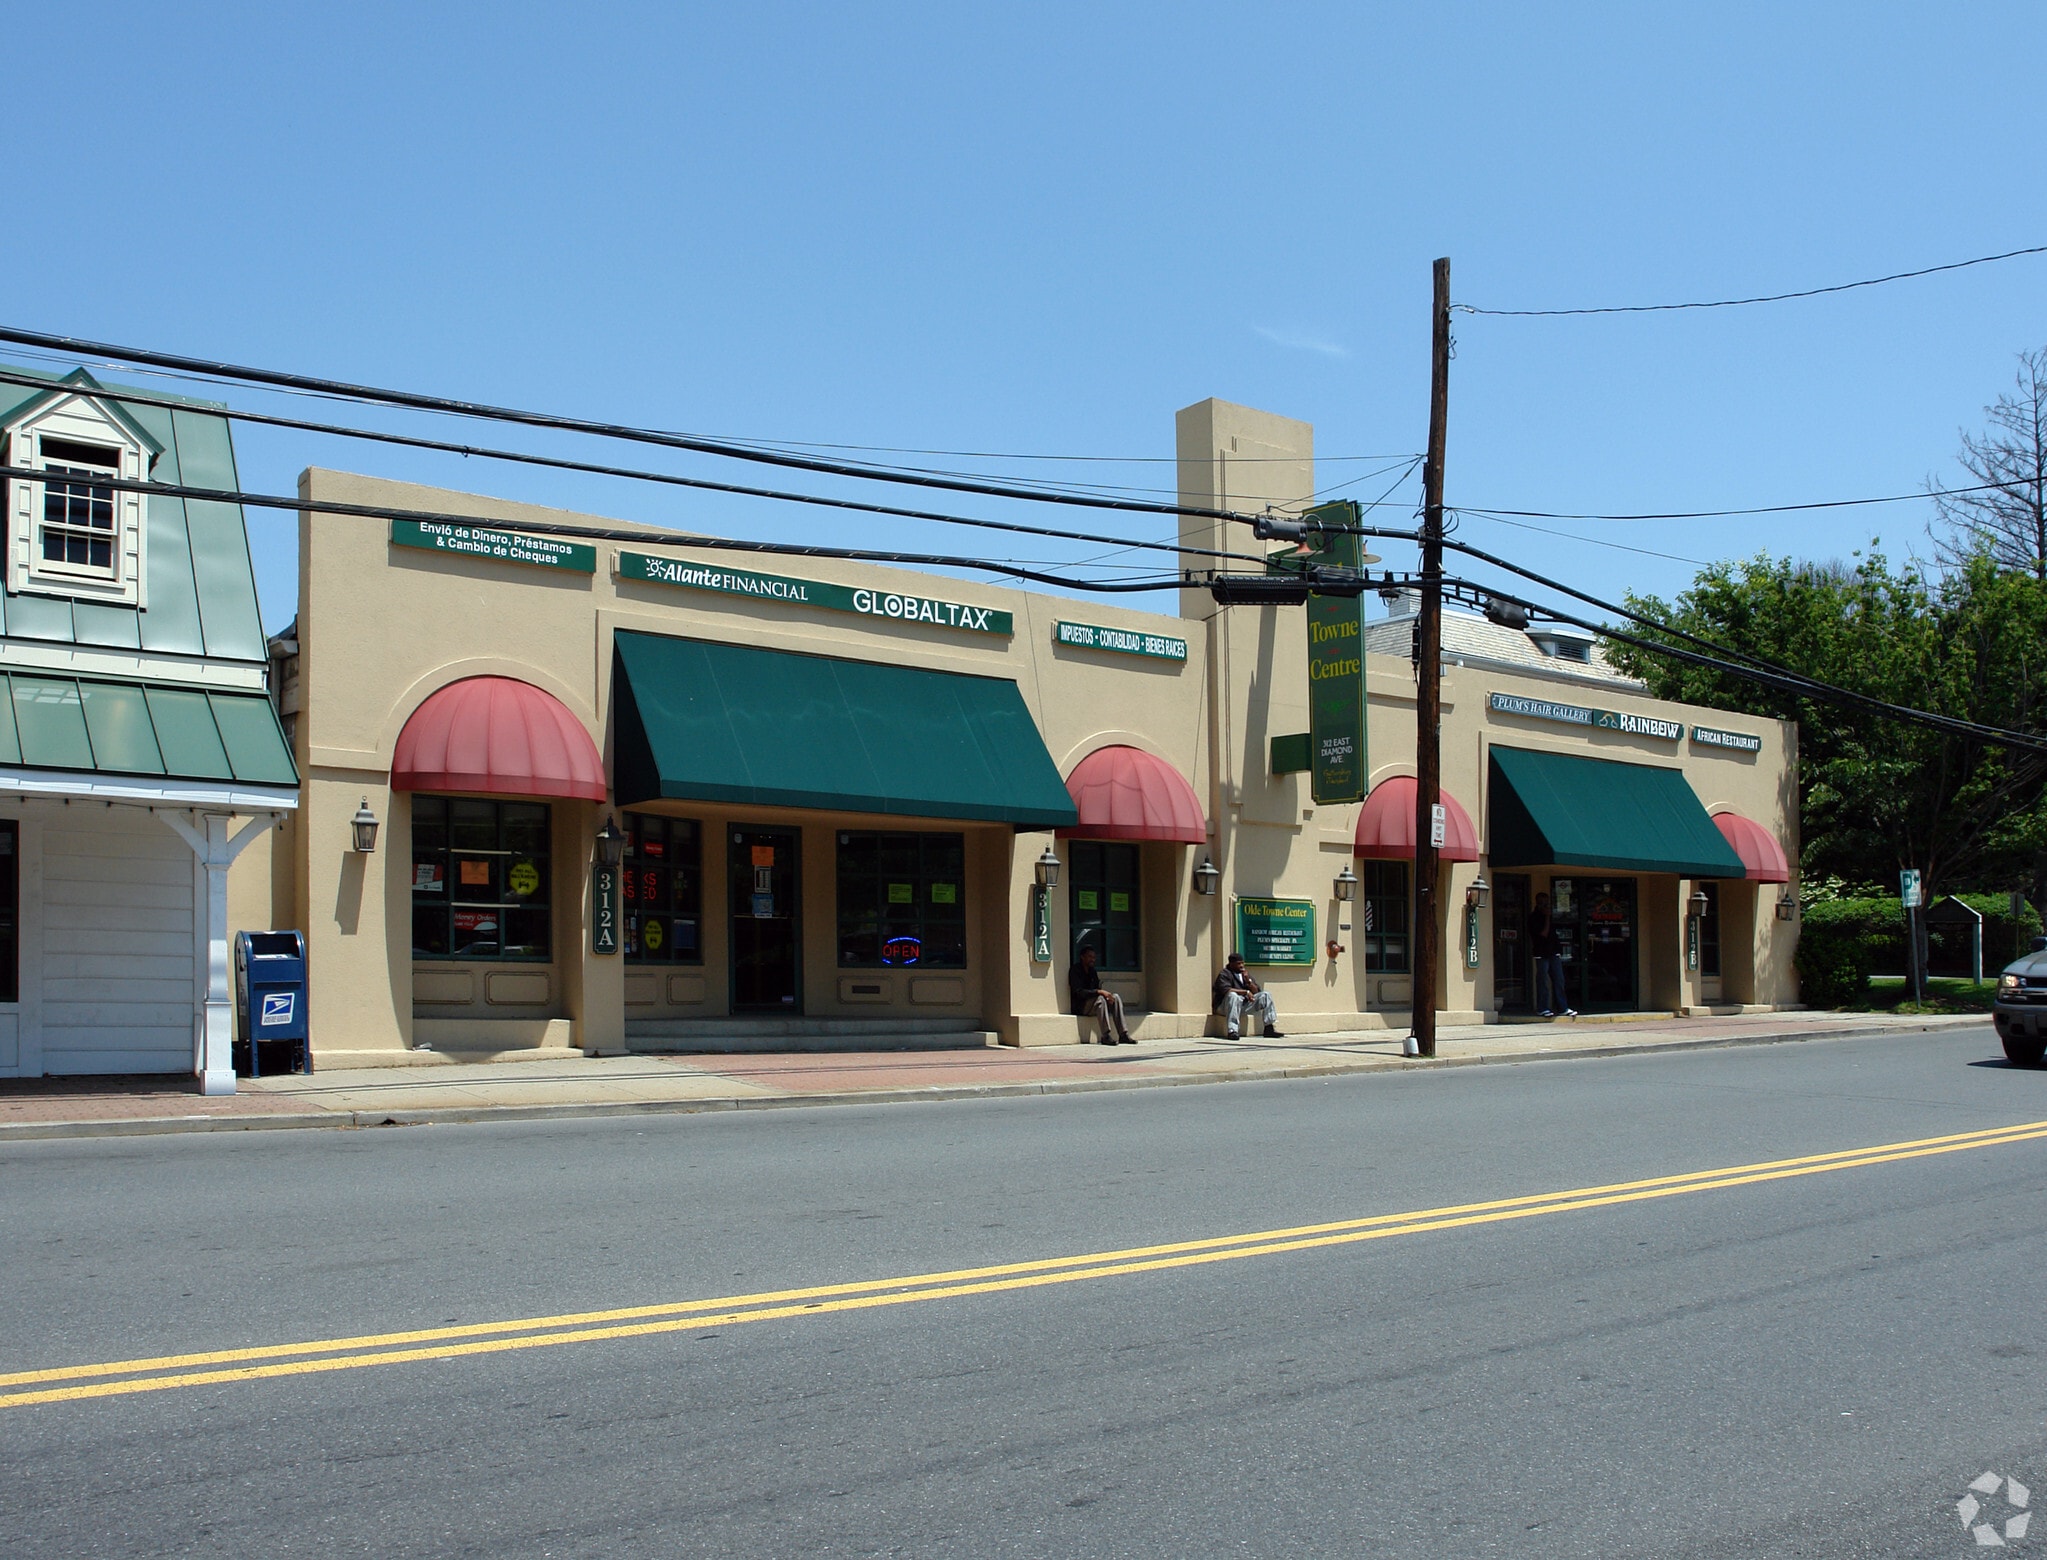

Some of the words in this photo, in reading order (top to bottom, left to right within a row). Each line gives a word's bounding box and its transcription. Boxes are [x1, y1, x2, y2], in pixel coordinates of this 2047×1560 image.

[420, 521, 452, 536] Envió
[455, 526, 469, 539] de
[472, 529, 511, 546] Dinero,
[514, 536, 573, 555] Préstamos
[436, 536, 445, 547] &
[448, 538, 491, 554] Cambio
[493, 544, 507, 558] de
[510, 547, 558, 564] Cheques
[663, 564, 721, 588] Alante
[722, 574, 809, 601] FINANCIAL
[1060, 624, 1094, 645] IMPUESTOS
[1099, 630, 1140, 651] CONTABILIDAD
[1145, 636, 1165, 655] BIENES
[1311, 620, 1359, 644] Towne
[1310, 658, 1361, 680] Centre
[1530, 703, 1552, 715] HAIR
[1552, 706, 1589, 722] GALLERY
[1619, 713, 1680, 739] RAINBOW
[1321, 745, 1353, 757] DIAMOND
[1333, 736, 1351, 747] EAST
[1696, 728, 1721, 745] AFRICAN
[1722, 733, 1759, 750] RESTAURANT
[598, 873, 614, 946] 312A
[1284, 906, 1307, 918] Center
[1037, 892, 1050, 955] 312A
[1469, 911, 1478, 963] 312B
[881, 944, 920, 958] OPEN
